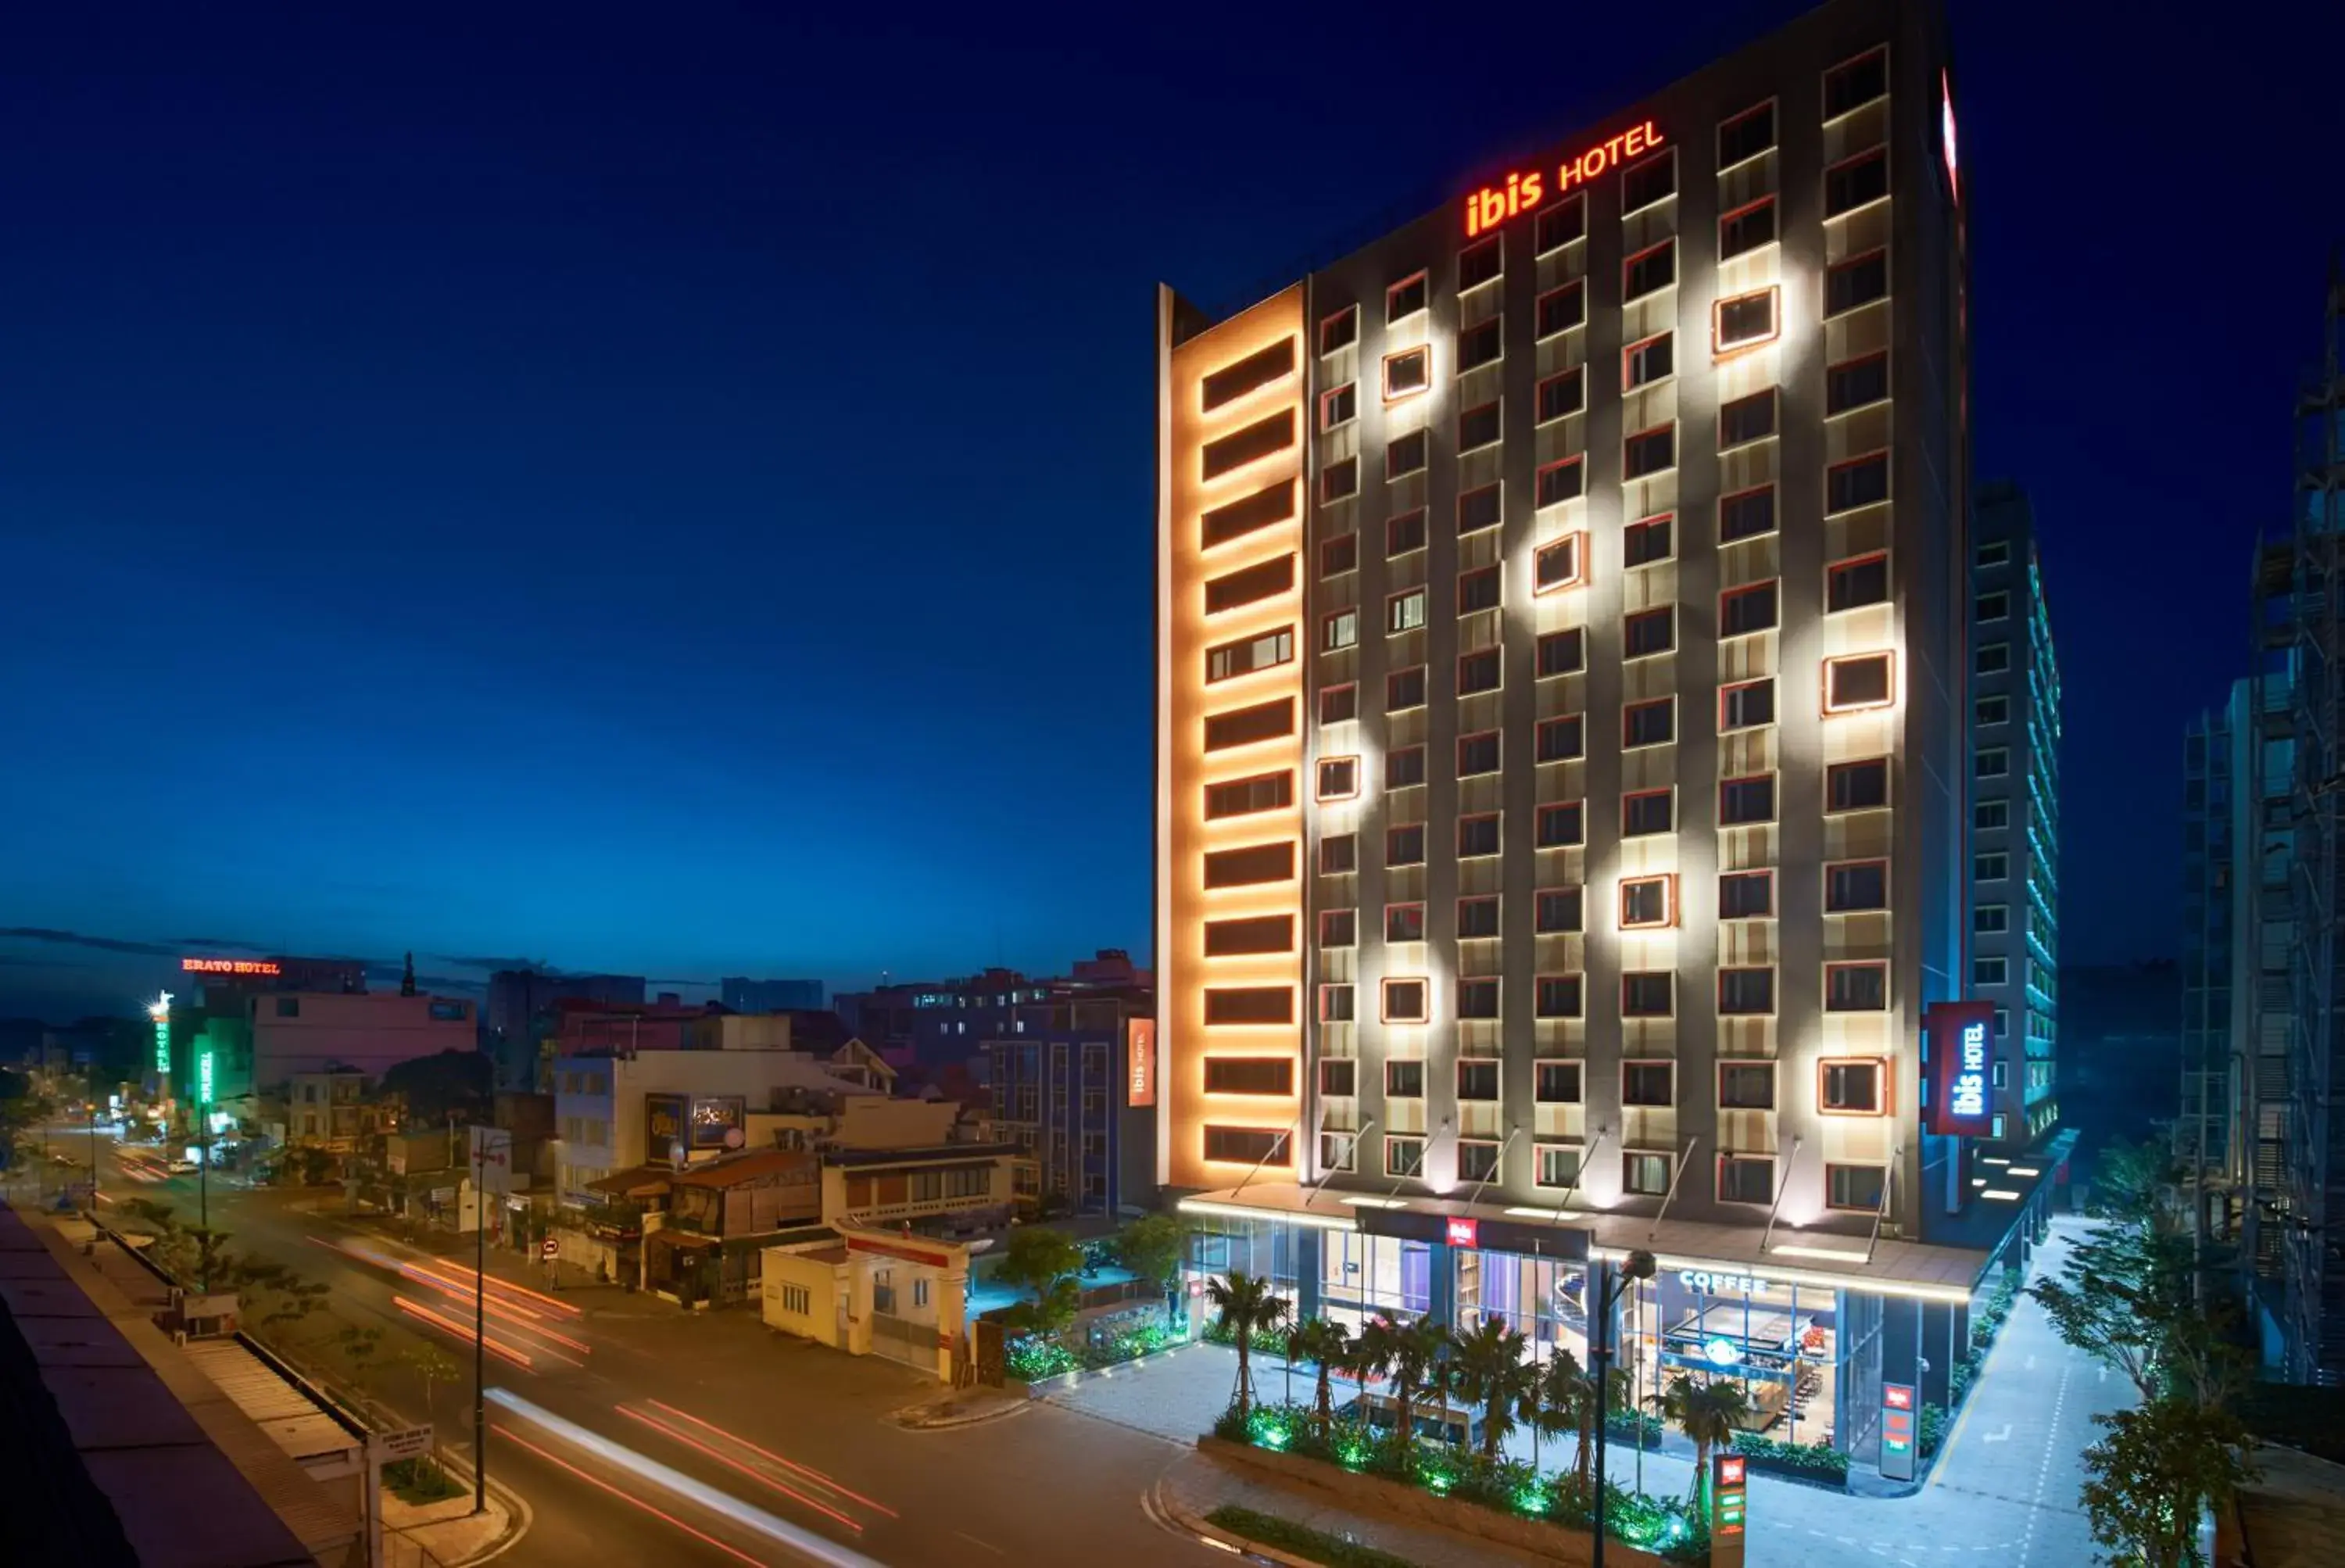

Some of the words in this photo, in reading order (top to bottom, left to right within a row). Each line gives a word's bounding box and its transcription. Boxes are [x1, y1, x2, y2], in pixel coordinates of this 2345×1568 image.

[1466, 171, 1543, 238] ibis
[1559, 120, 1664, 192] HOTEL
[182, 958, 232, 972] ERATO
[234, 961, 281, 975] HOTEL
[1964, 1022, 1984, 1070] HOTEL
[1953, 1075, 1984, 1115] ibis
[1679, 1270, 1768, 1293] COFFEE
